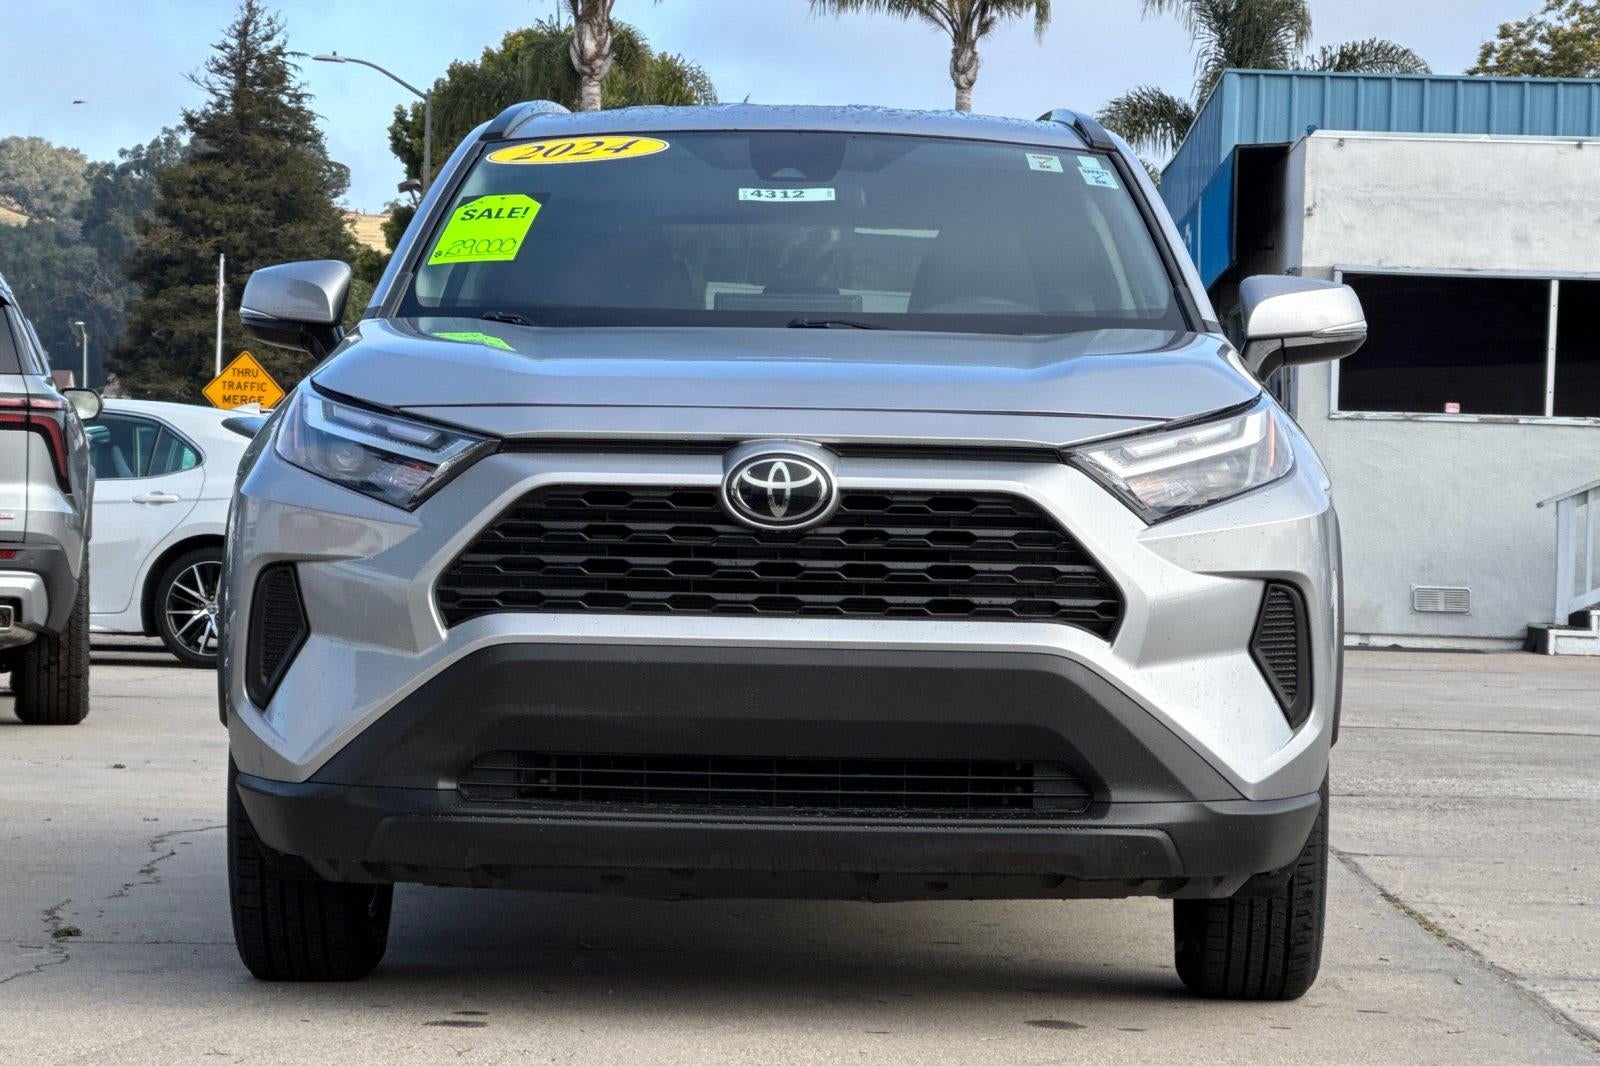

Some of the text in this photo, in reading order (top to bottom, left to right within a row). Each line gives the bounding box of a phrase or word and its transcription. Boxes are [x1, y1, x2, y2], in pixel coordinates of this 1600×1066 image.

[513, 139, 641, 160] 2024
[750, 190, 805, 199] 4312
[460, 206, 531, 221] SALE!
[231, 367, 259, 378] THRU
[221, 380, 267, 392] TRAFFIC
[222, 394, 265, 405] MERGE
